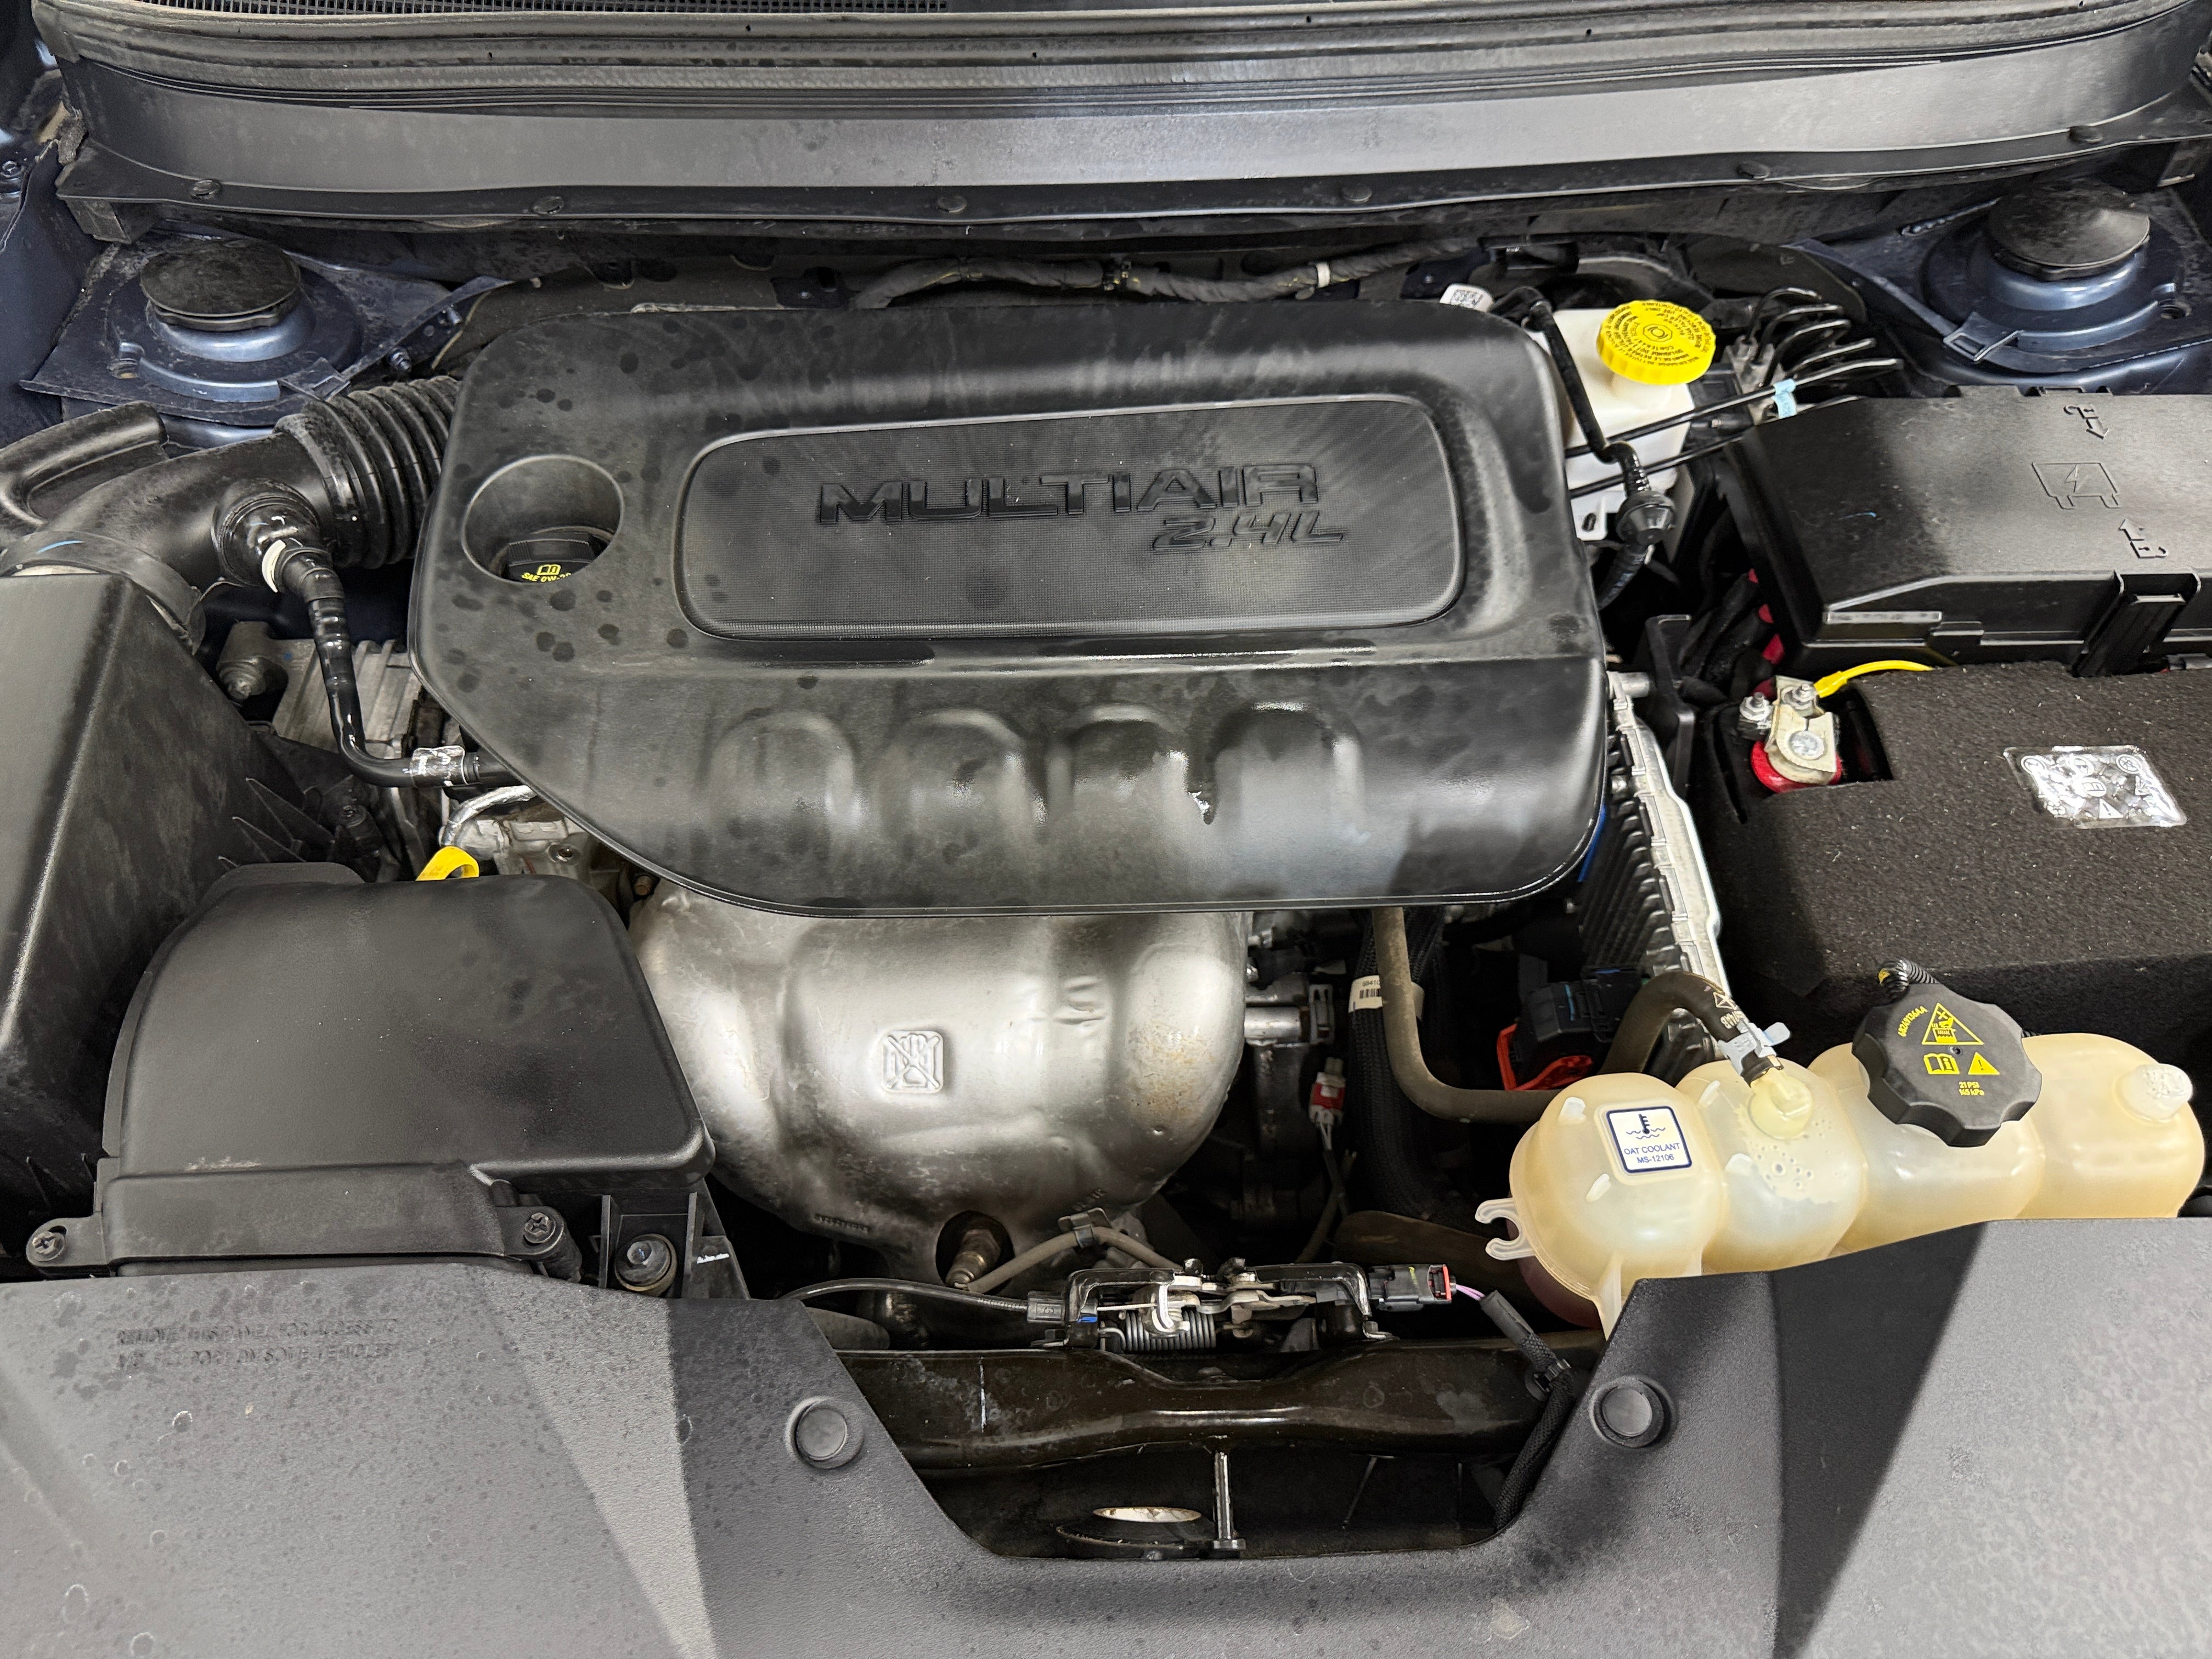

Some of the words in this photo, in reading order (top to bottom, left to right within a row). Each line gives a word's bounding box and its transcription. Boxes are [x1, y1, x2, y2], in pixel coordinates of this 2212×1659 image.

[820, 464, 1318, 524] MULTIAIR
[1153, 509, 1344, 549] 2.4L
[521, 572, 540, 582] SAE
[1641, 1142, 1680, 1154] COOLANT
[1637, 1154, 1674, 1163] MS-12106
